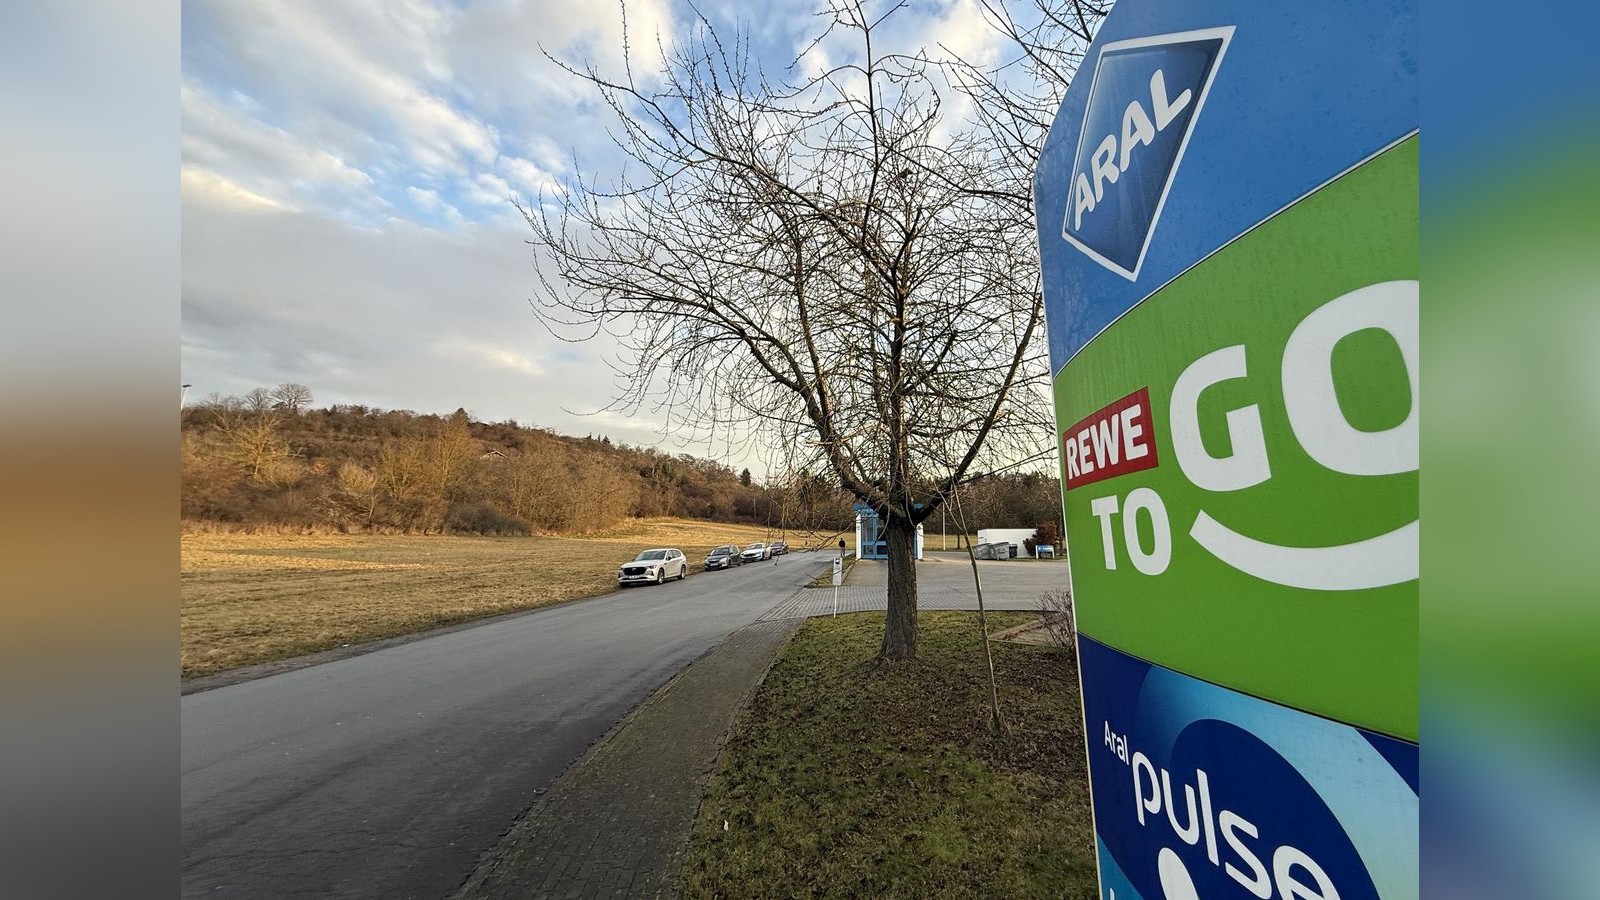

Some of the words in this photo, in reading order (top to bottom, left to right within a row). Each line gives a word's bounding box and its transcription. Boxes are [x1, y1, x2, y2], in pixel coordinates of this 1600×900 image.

[1074, 69, 1192, 231] ARAL
[1066, 403, 1149, 480] REWE
[1170, 280, 1419, 491] GO
[1091, 487, 1172, 576] TO
[1104, 720, 1130, 766] Aral
[1132, 752, 1341, 900] pulse
